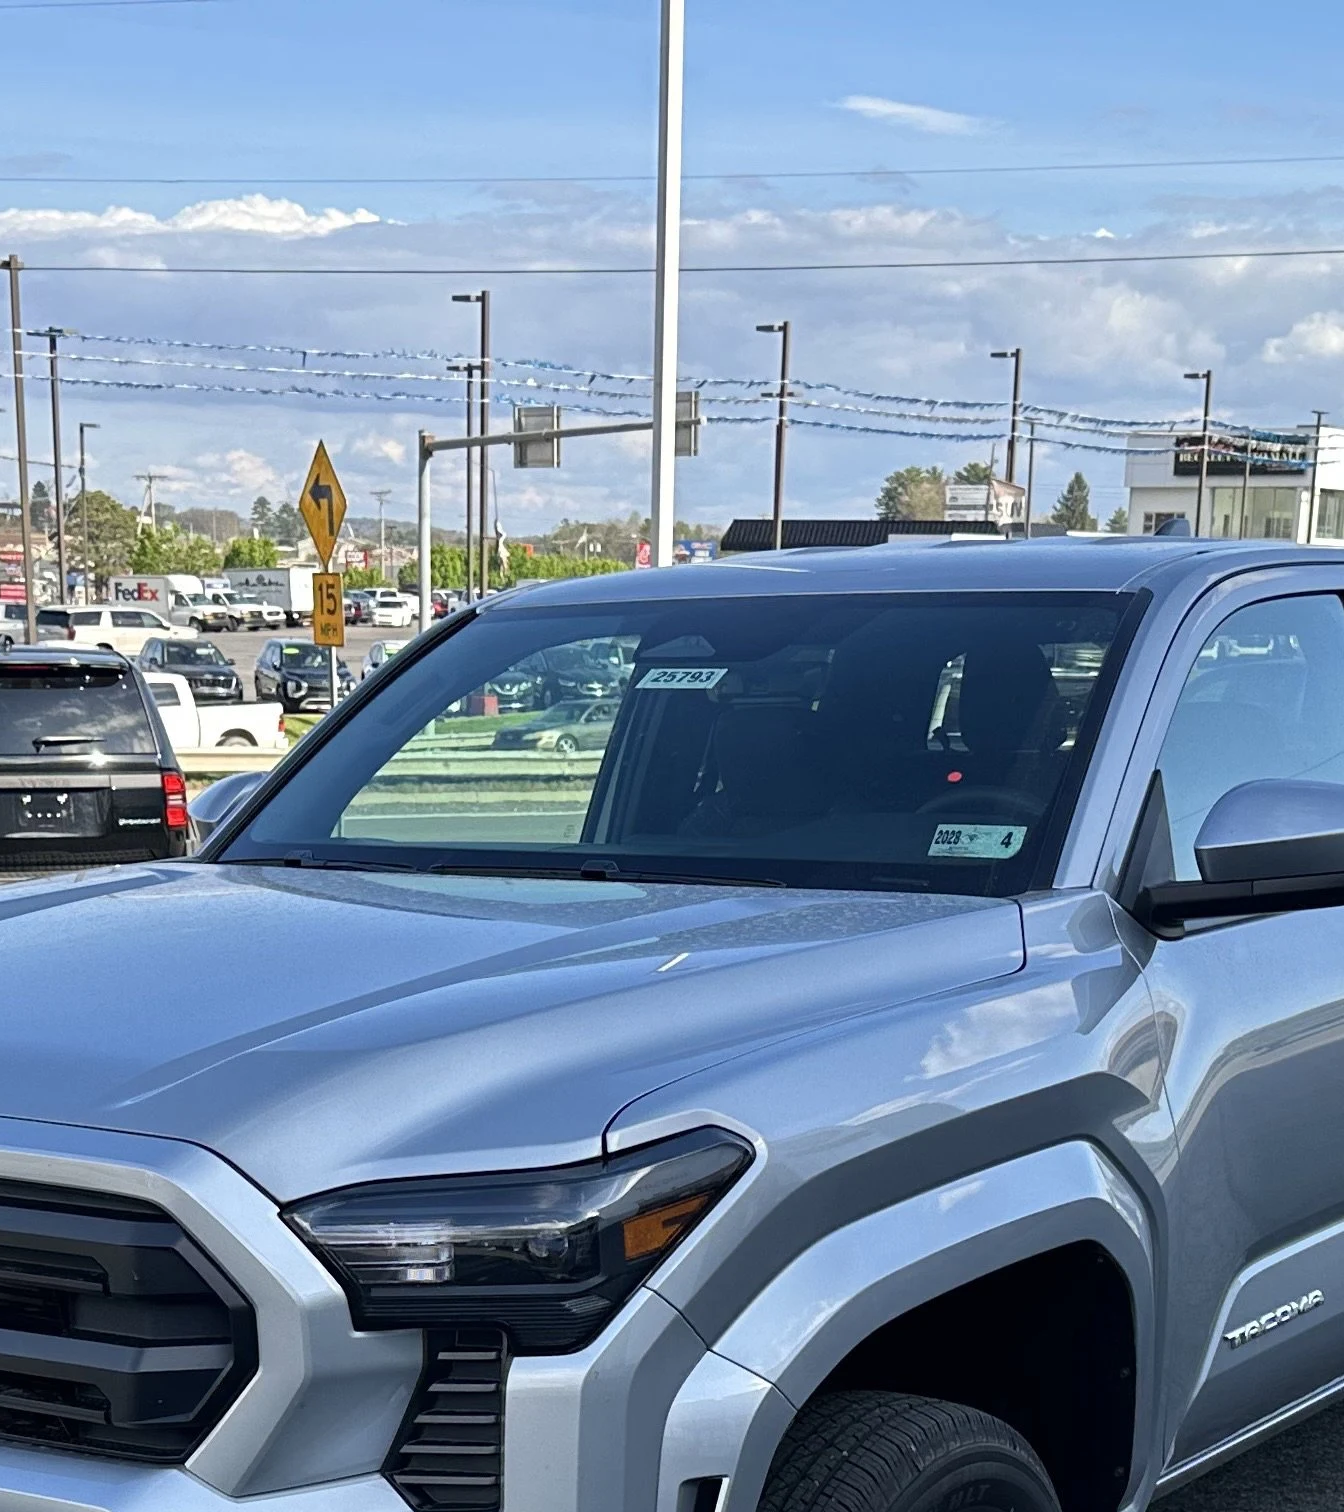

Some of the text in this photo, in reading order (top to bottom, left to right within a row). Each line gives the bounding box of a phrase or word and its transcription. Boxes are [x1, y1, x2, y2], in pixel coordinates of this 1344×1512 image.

[114, 582, 159, 601] FedEx
[318, 582, 337, 615] 15
[320, 622, 338, 637] MPH
[650, 671, 716, 683] 25793
[1000, 831, 1014, 849] 4
[1223, 1288, 1326, 1350] TACOMA
